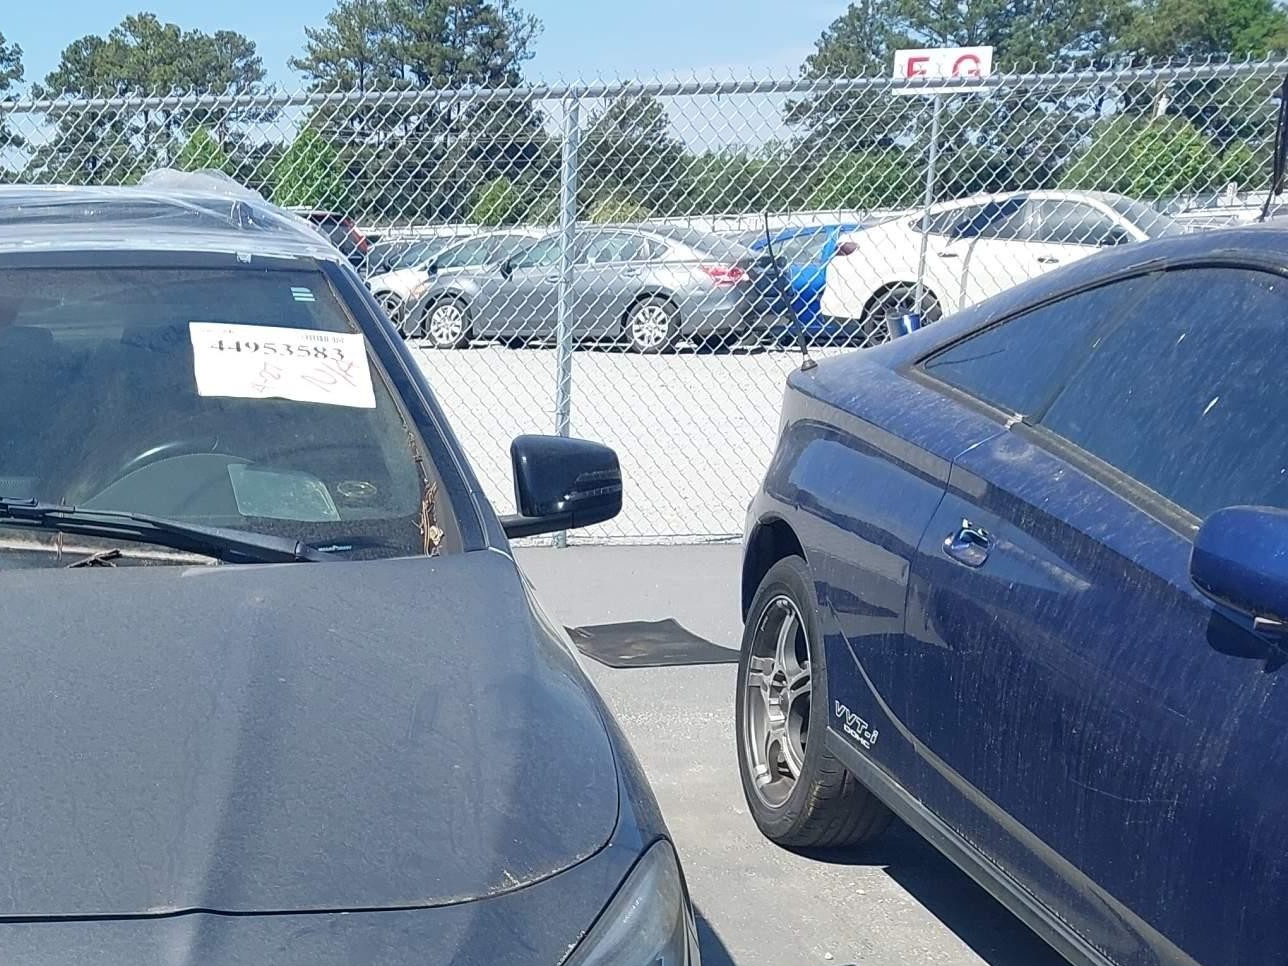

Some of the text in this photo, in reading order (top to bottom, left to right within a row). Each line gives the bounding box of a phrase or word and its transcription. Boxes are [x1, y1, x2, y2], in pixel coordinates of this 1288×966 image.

[952, 54, 981, 78] G
[210, 340, 345, 361] 44953583
[835, 700, 879, 744] VVT-i
[843, 723, 871, 749] DOHC
